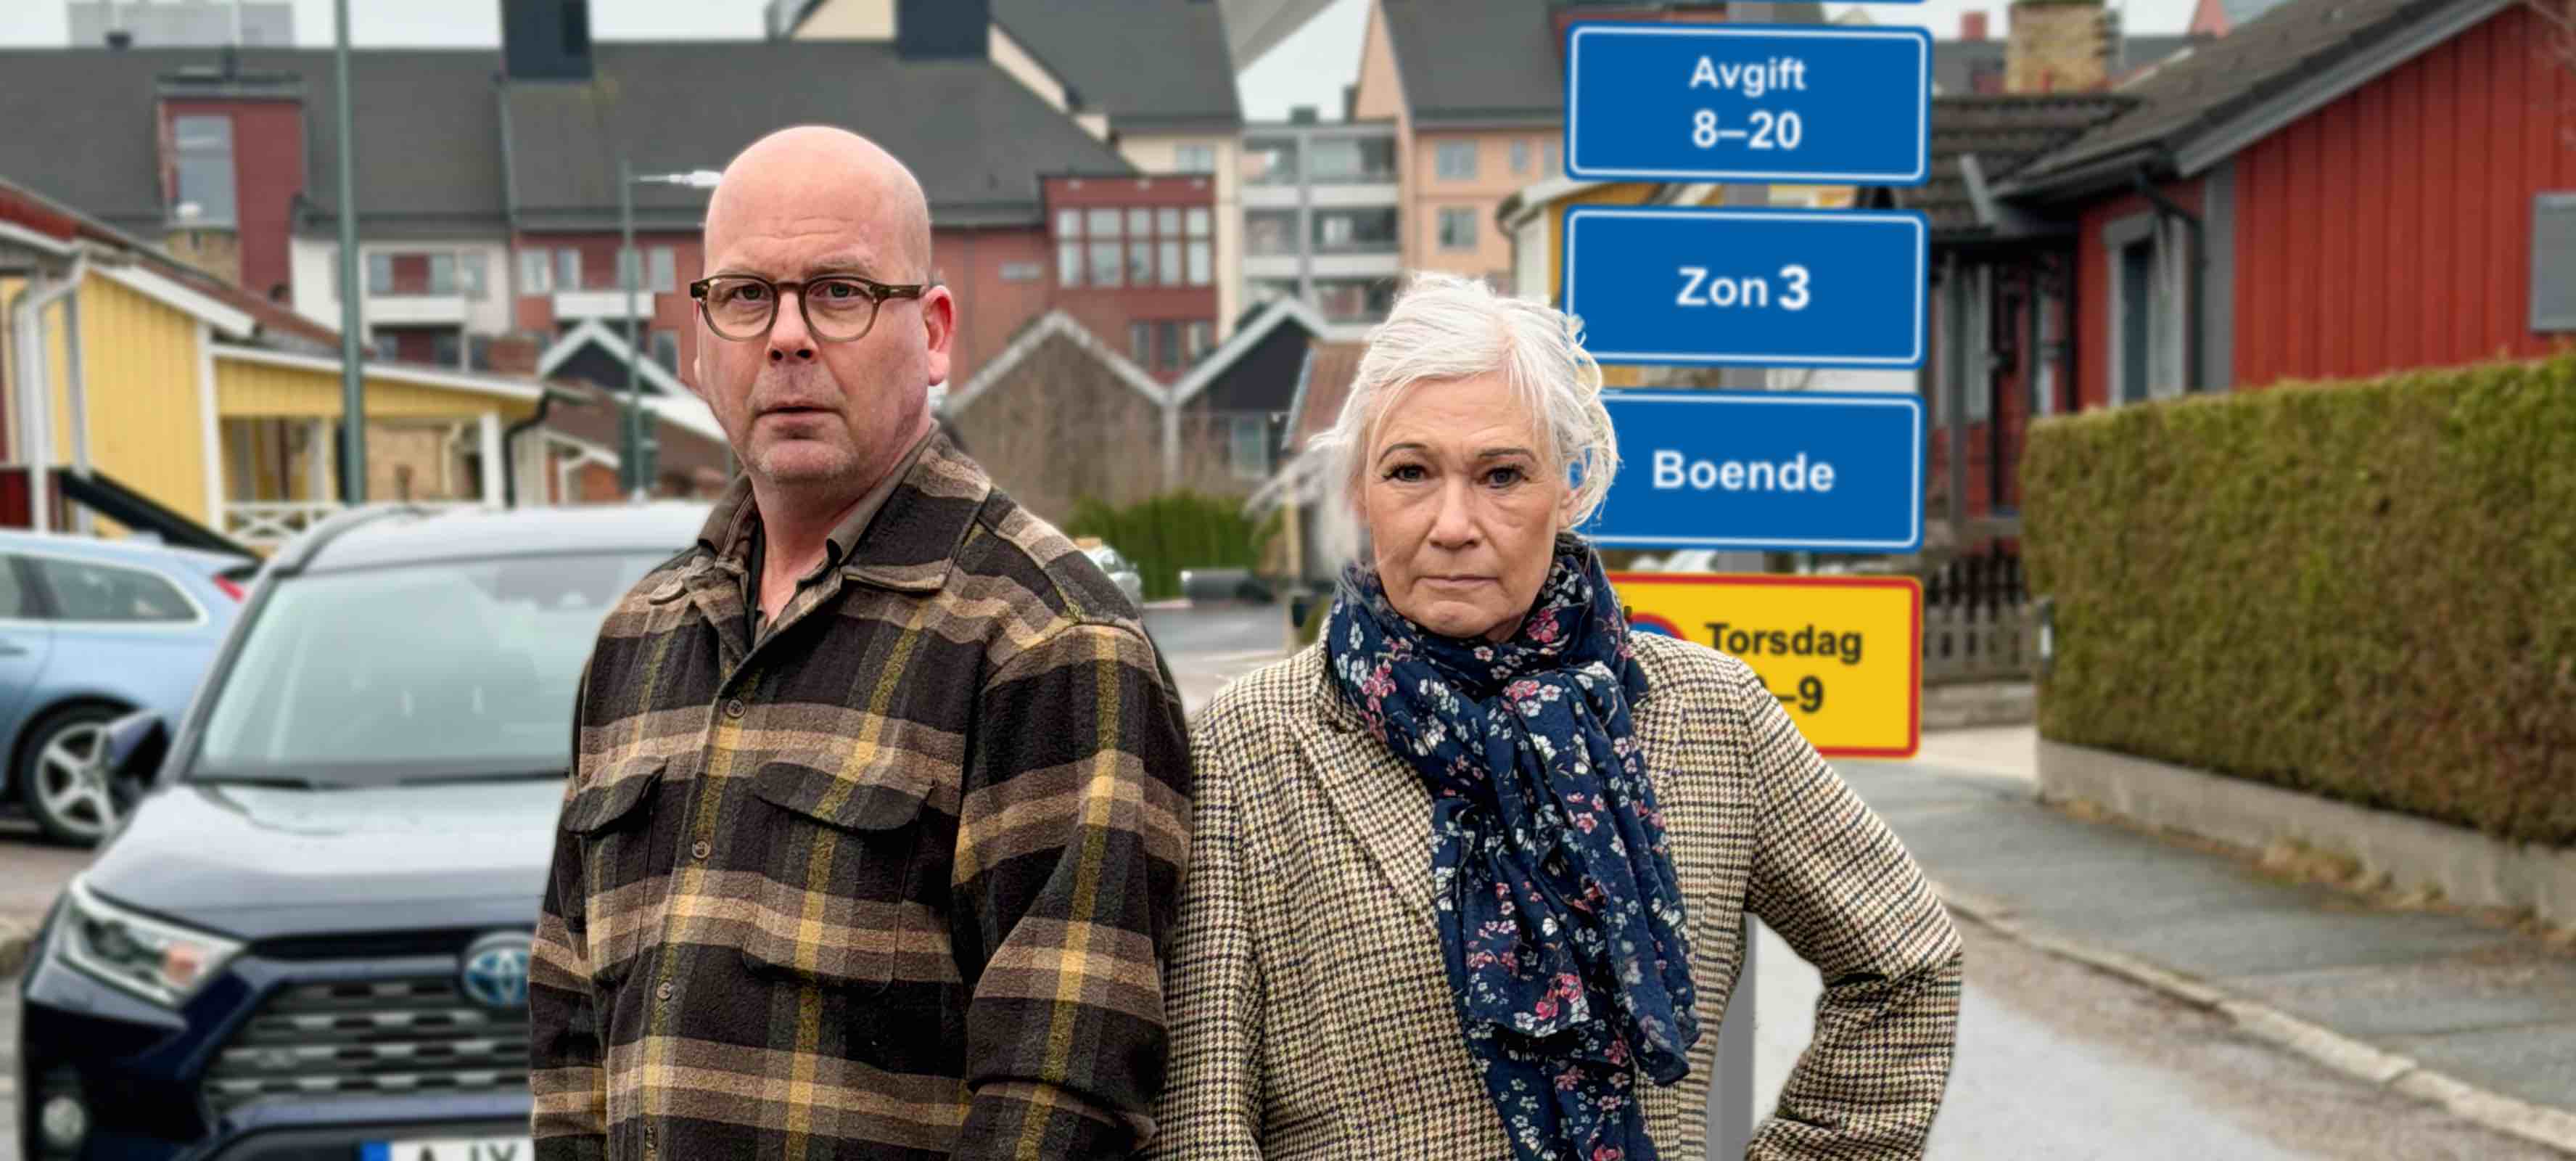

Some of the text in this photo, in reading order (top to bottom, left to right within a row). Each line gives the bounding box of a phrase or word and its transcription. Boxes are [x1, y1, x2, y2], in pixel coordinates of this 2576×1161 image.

[1690, 57, 1806, 97] Avgift
[1692, 110, 1802, 149] 8–20
[1676, 264, 1810, 311] Zon 3
[1653, 450, 1835, 492] Boende
[1705, 623, 1862, 665] Torsdag
[1756, 676, 1824, 713] –9
